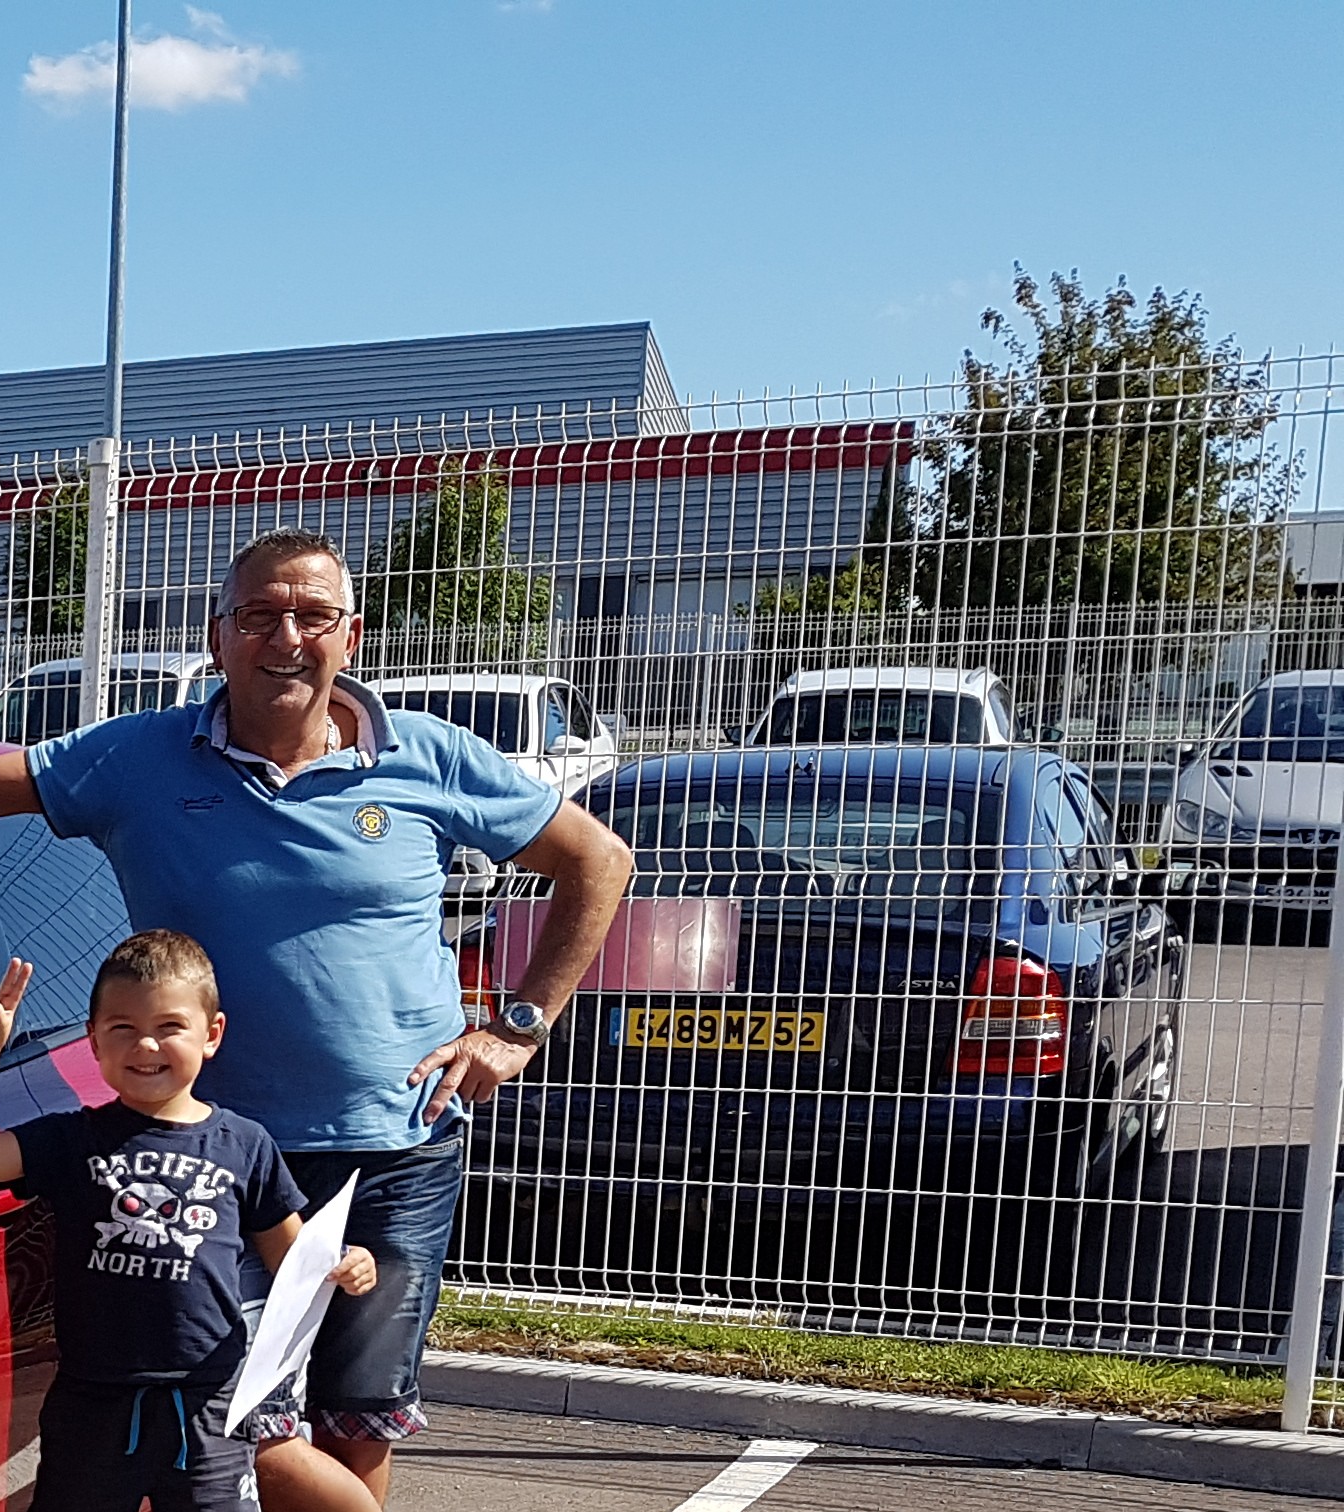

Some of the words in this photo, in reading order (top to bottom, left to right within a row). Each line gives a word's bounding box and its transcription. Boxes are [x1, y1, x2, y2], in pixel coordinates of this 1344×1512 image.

[898, 980, 956, 989] ASTRA
[635, 1013, 717, 1044] 5489
[724, 1015, 767, 1045] MZ
[774, 1016, 816, 1047] 52
[87, 1150, 236, 1196] PACIFIC
[87, 1249, 193, 1282] NORTH
